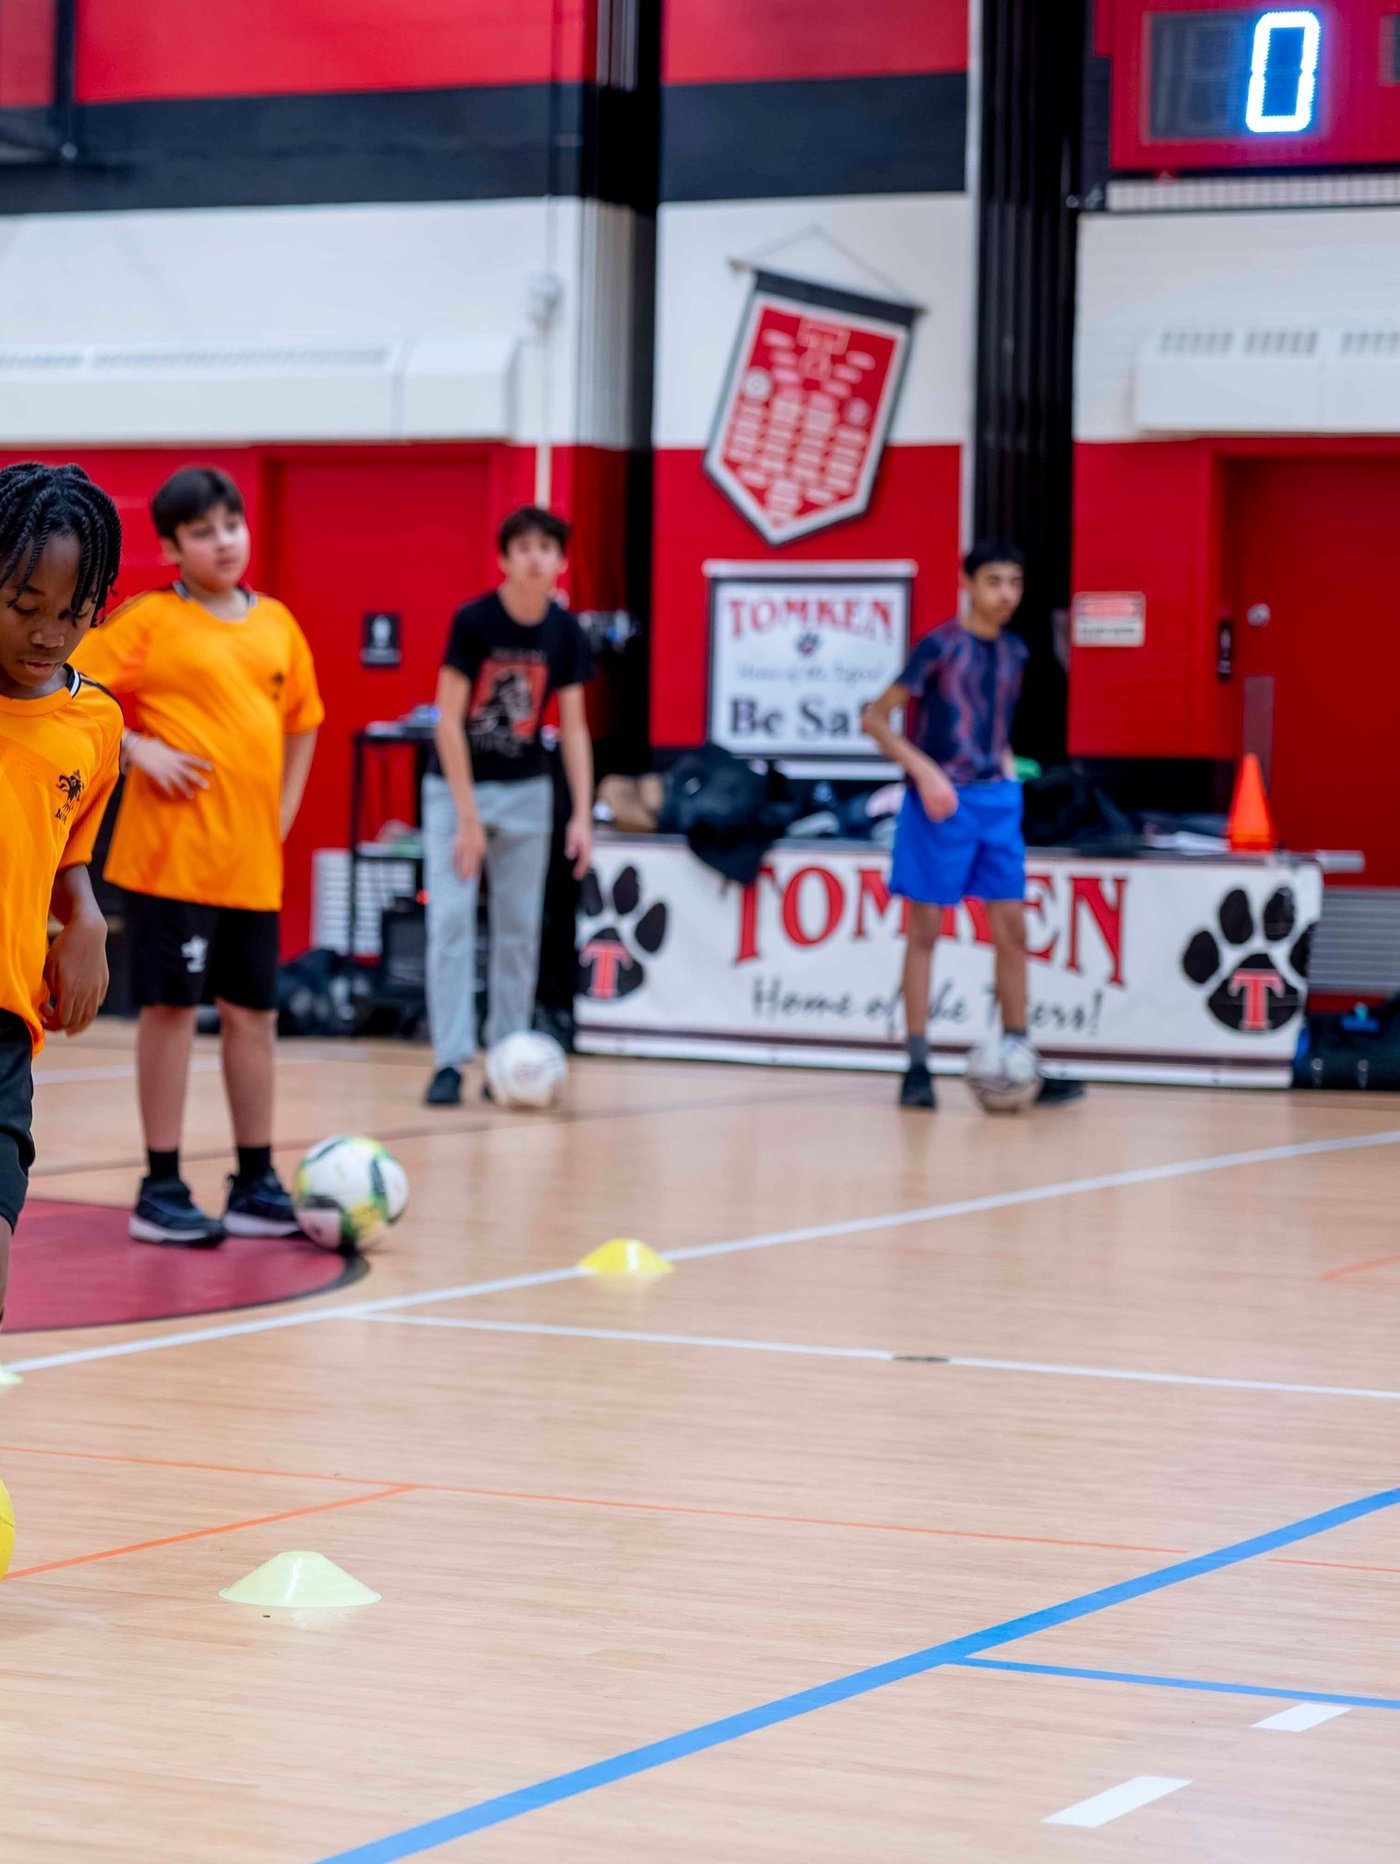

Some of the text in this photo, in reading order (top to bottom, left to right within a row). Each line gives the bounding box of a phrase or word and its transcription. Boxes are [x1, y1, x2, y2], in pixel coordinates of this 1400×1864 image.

[1245, 11, 1321, 133] 0
[729, 597, 894, 644] TOMKEN
[730, 697, 782, 737] Be
[580, 939, 634, 1000] T
[1229, 968, 1285, 1031] T
[753, 977, 852, 1021] Home
[865, 986, 904, 1040] of
[928, 976, 966, 1022] he
